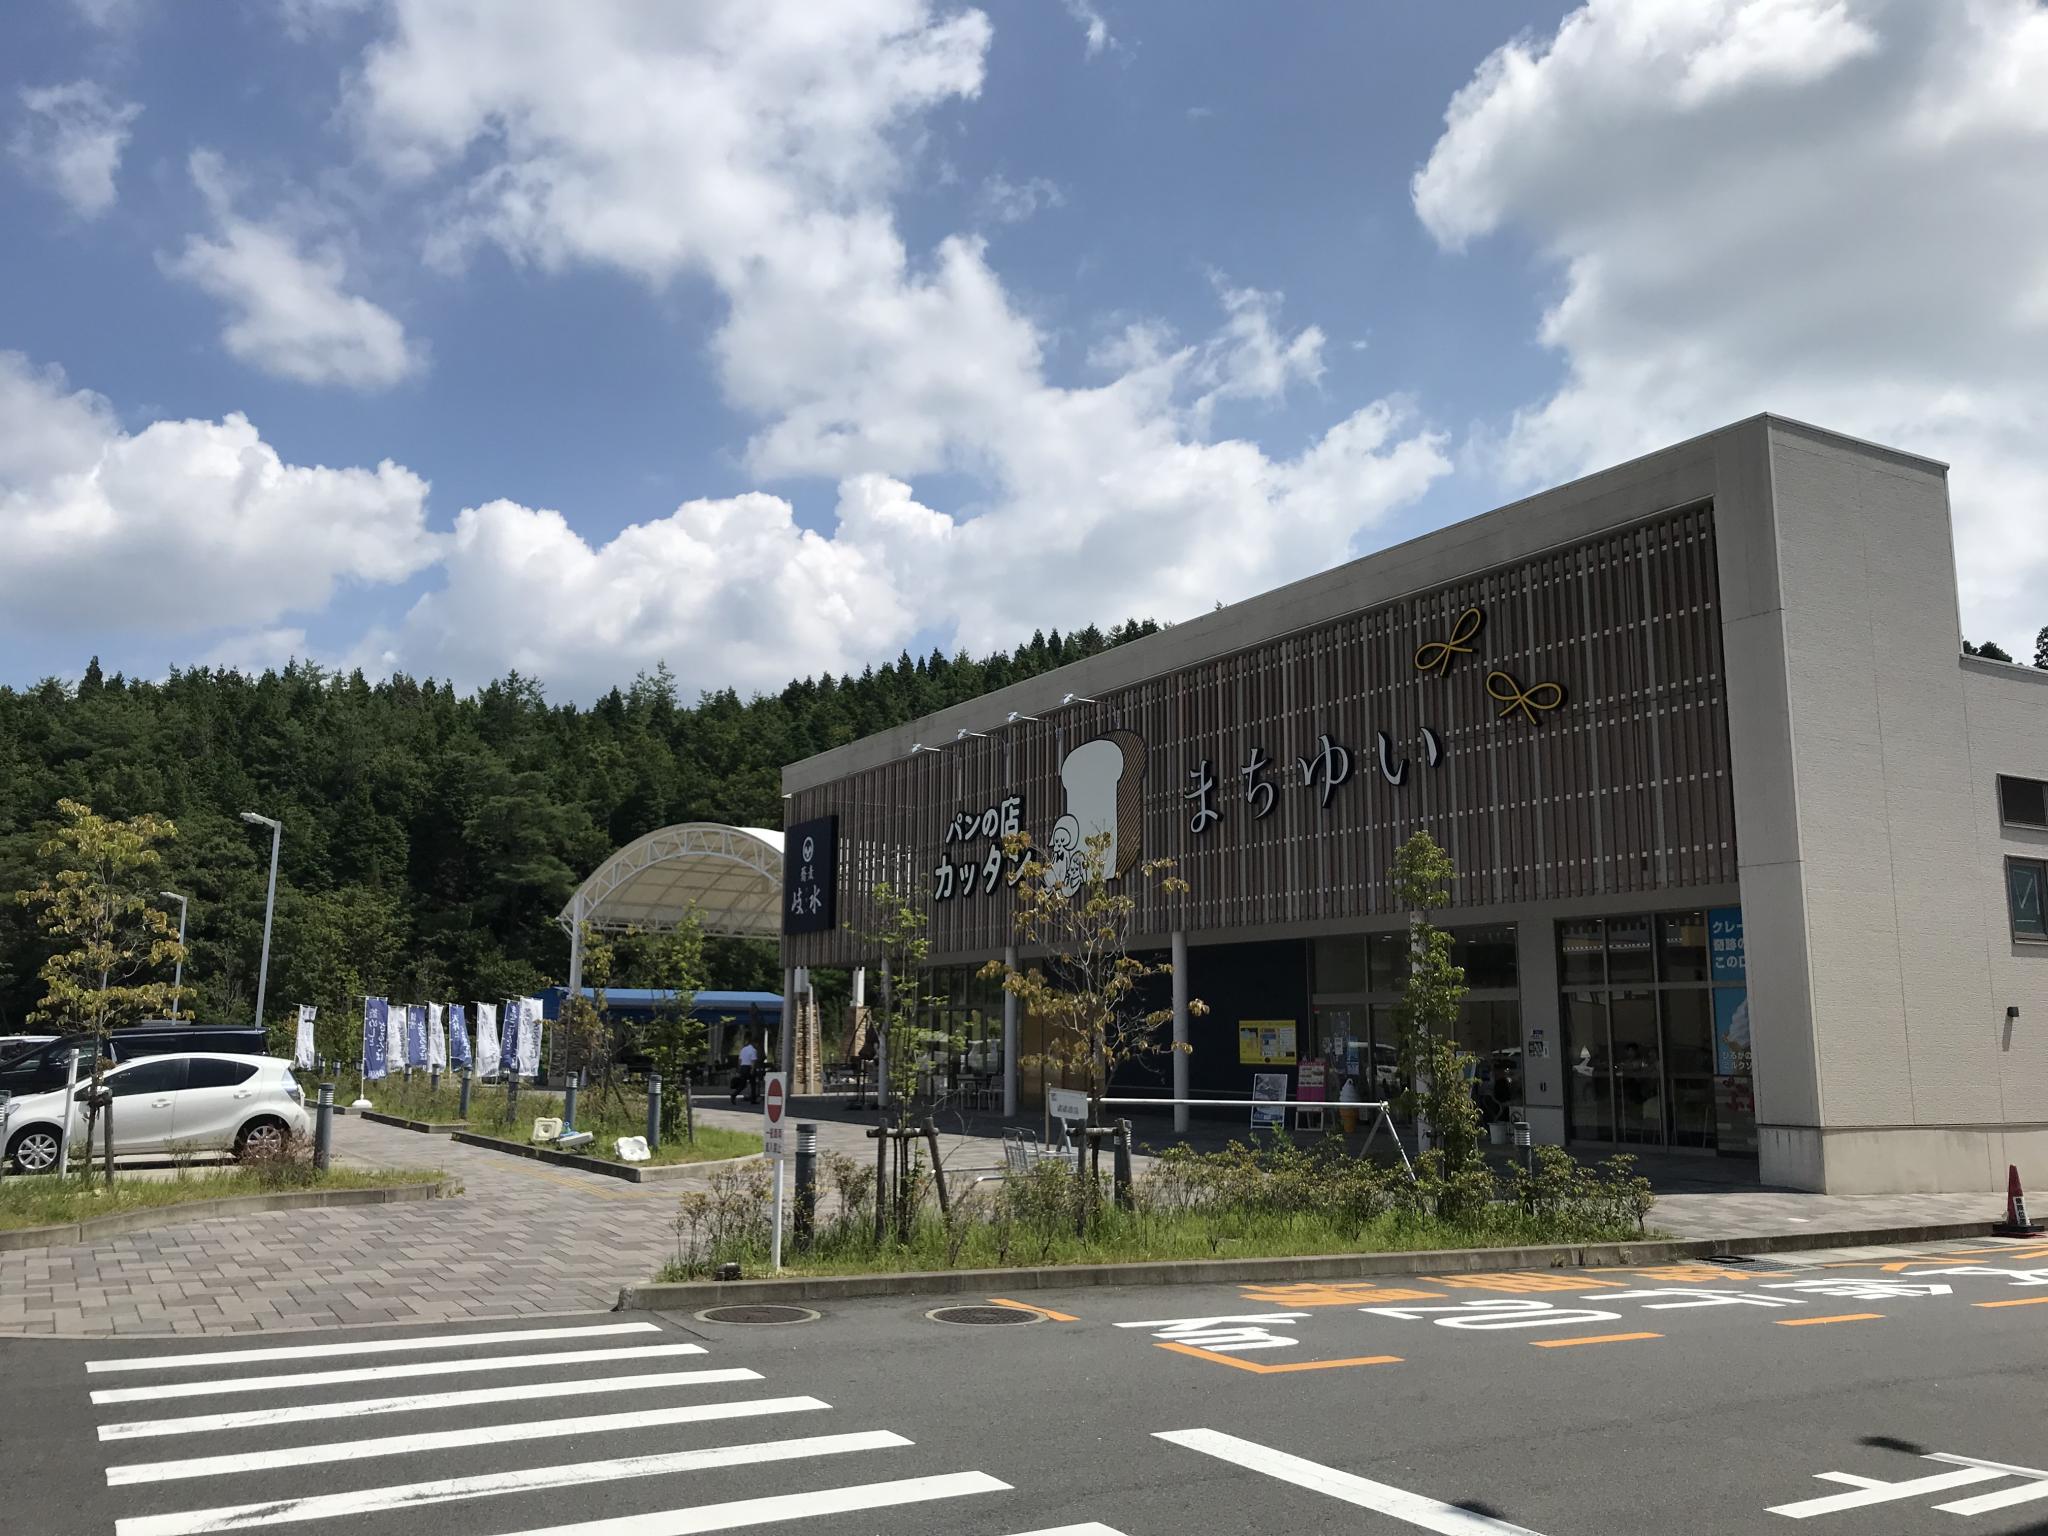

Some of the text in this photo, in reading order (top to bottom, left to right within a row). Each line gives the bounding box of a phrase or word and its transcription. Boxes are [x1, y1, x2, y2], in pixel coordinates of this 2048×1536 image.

[1184, 726, 1440, 834] まちゆい
[945, 796, 1022, 844] パンの店
[934, 844, 1032, 901] カッタン
